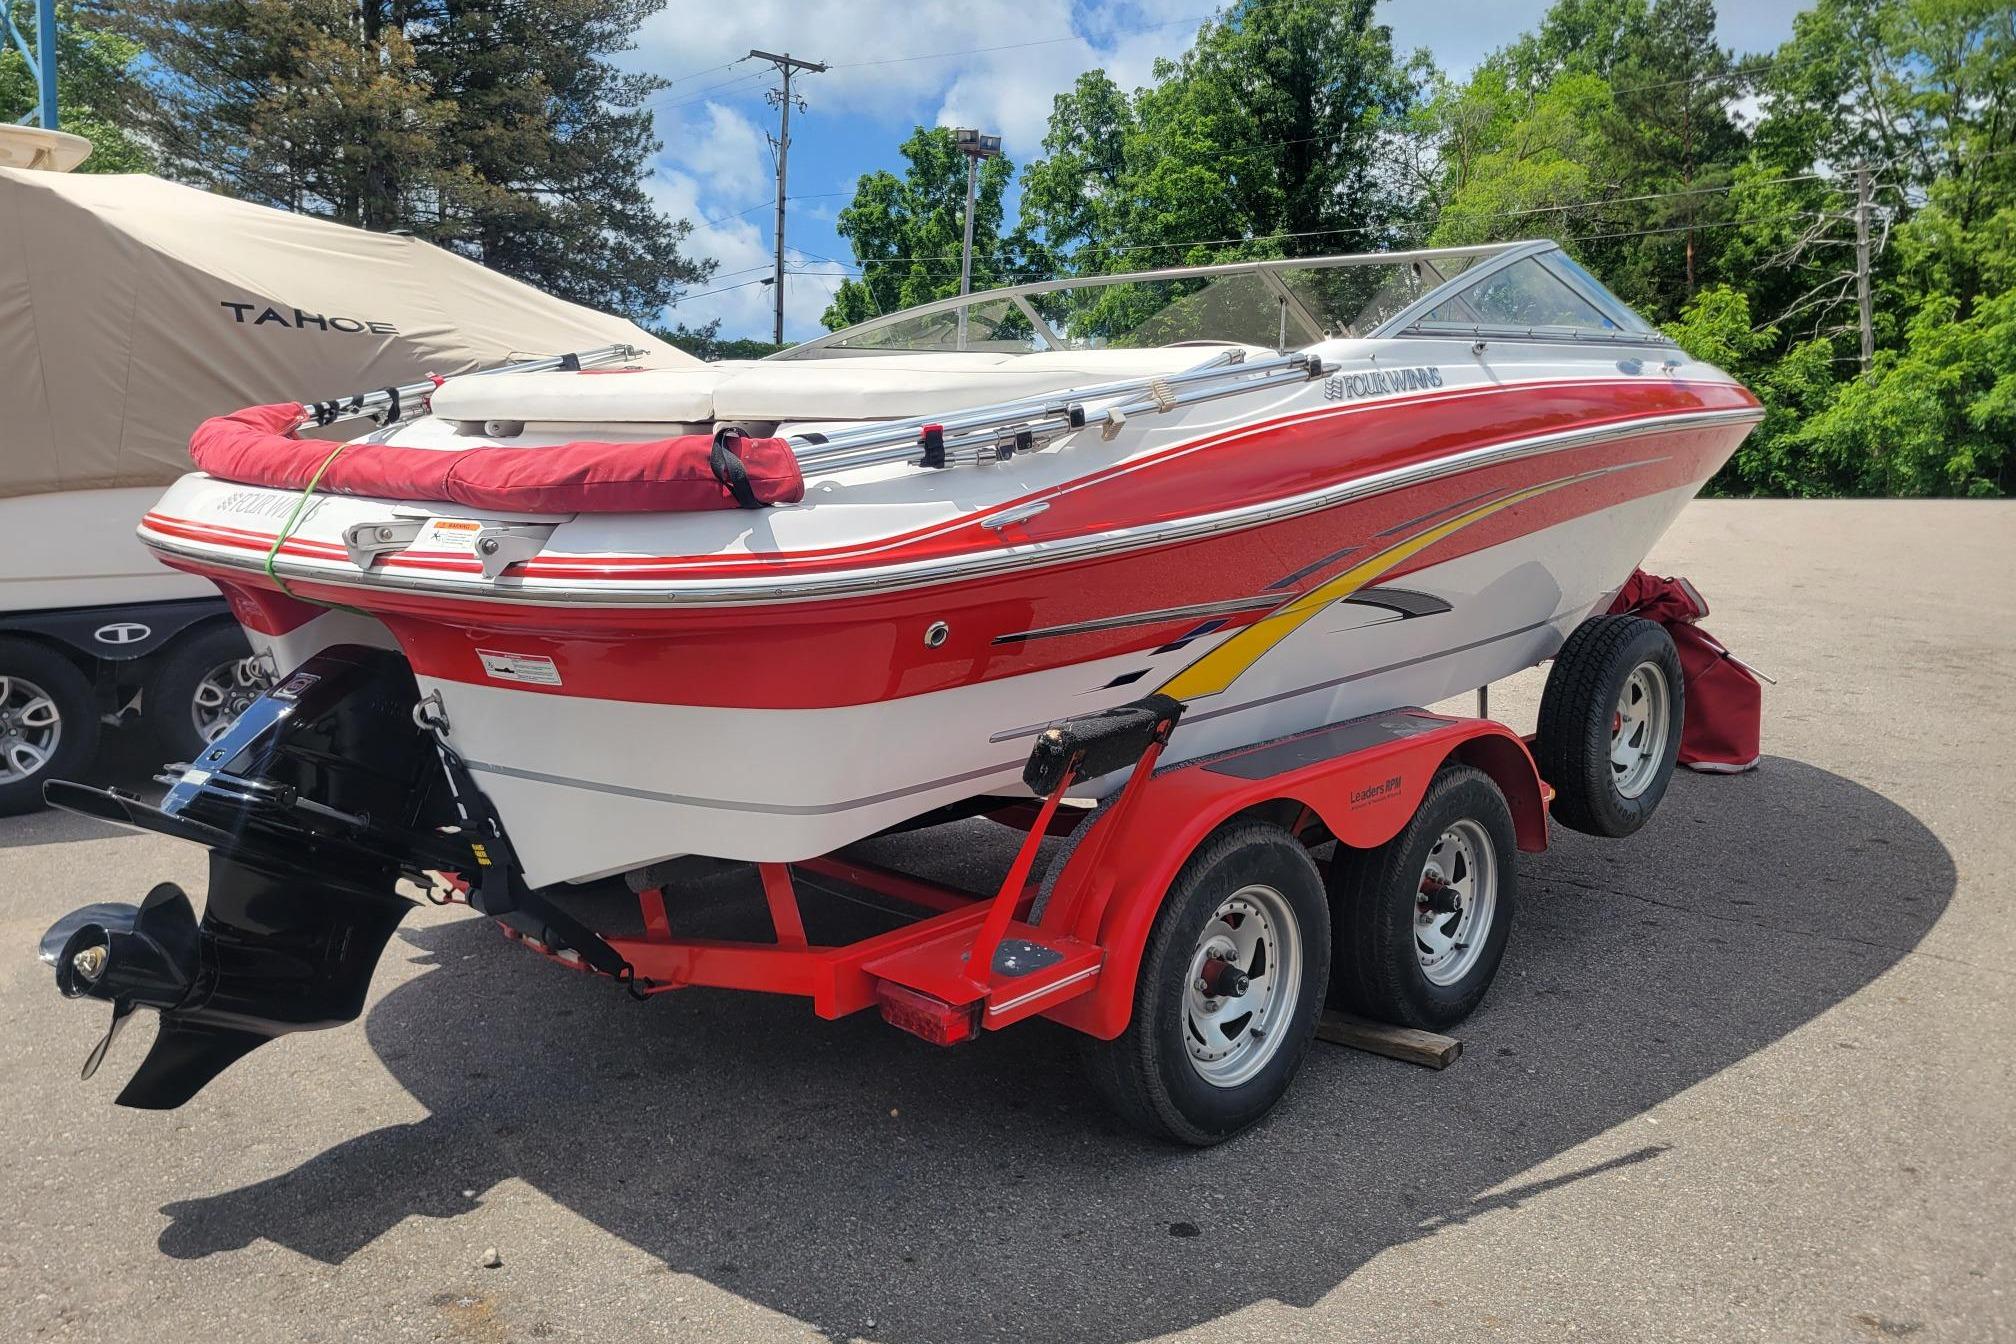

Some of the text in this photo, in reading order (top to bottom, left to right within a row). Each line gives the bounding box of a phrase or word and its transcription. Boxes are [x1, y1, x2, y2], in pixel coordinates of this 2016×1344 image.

[221, 301, 400, 335] TAHOE
[1343, 366, 1443, 399] FOUR WINNS
[1351, 785, 1385, 804] Leaders
